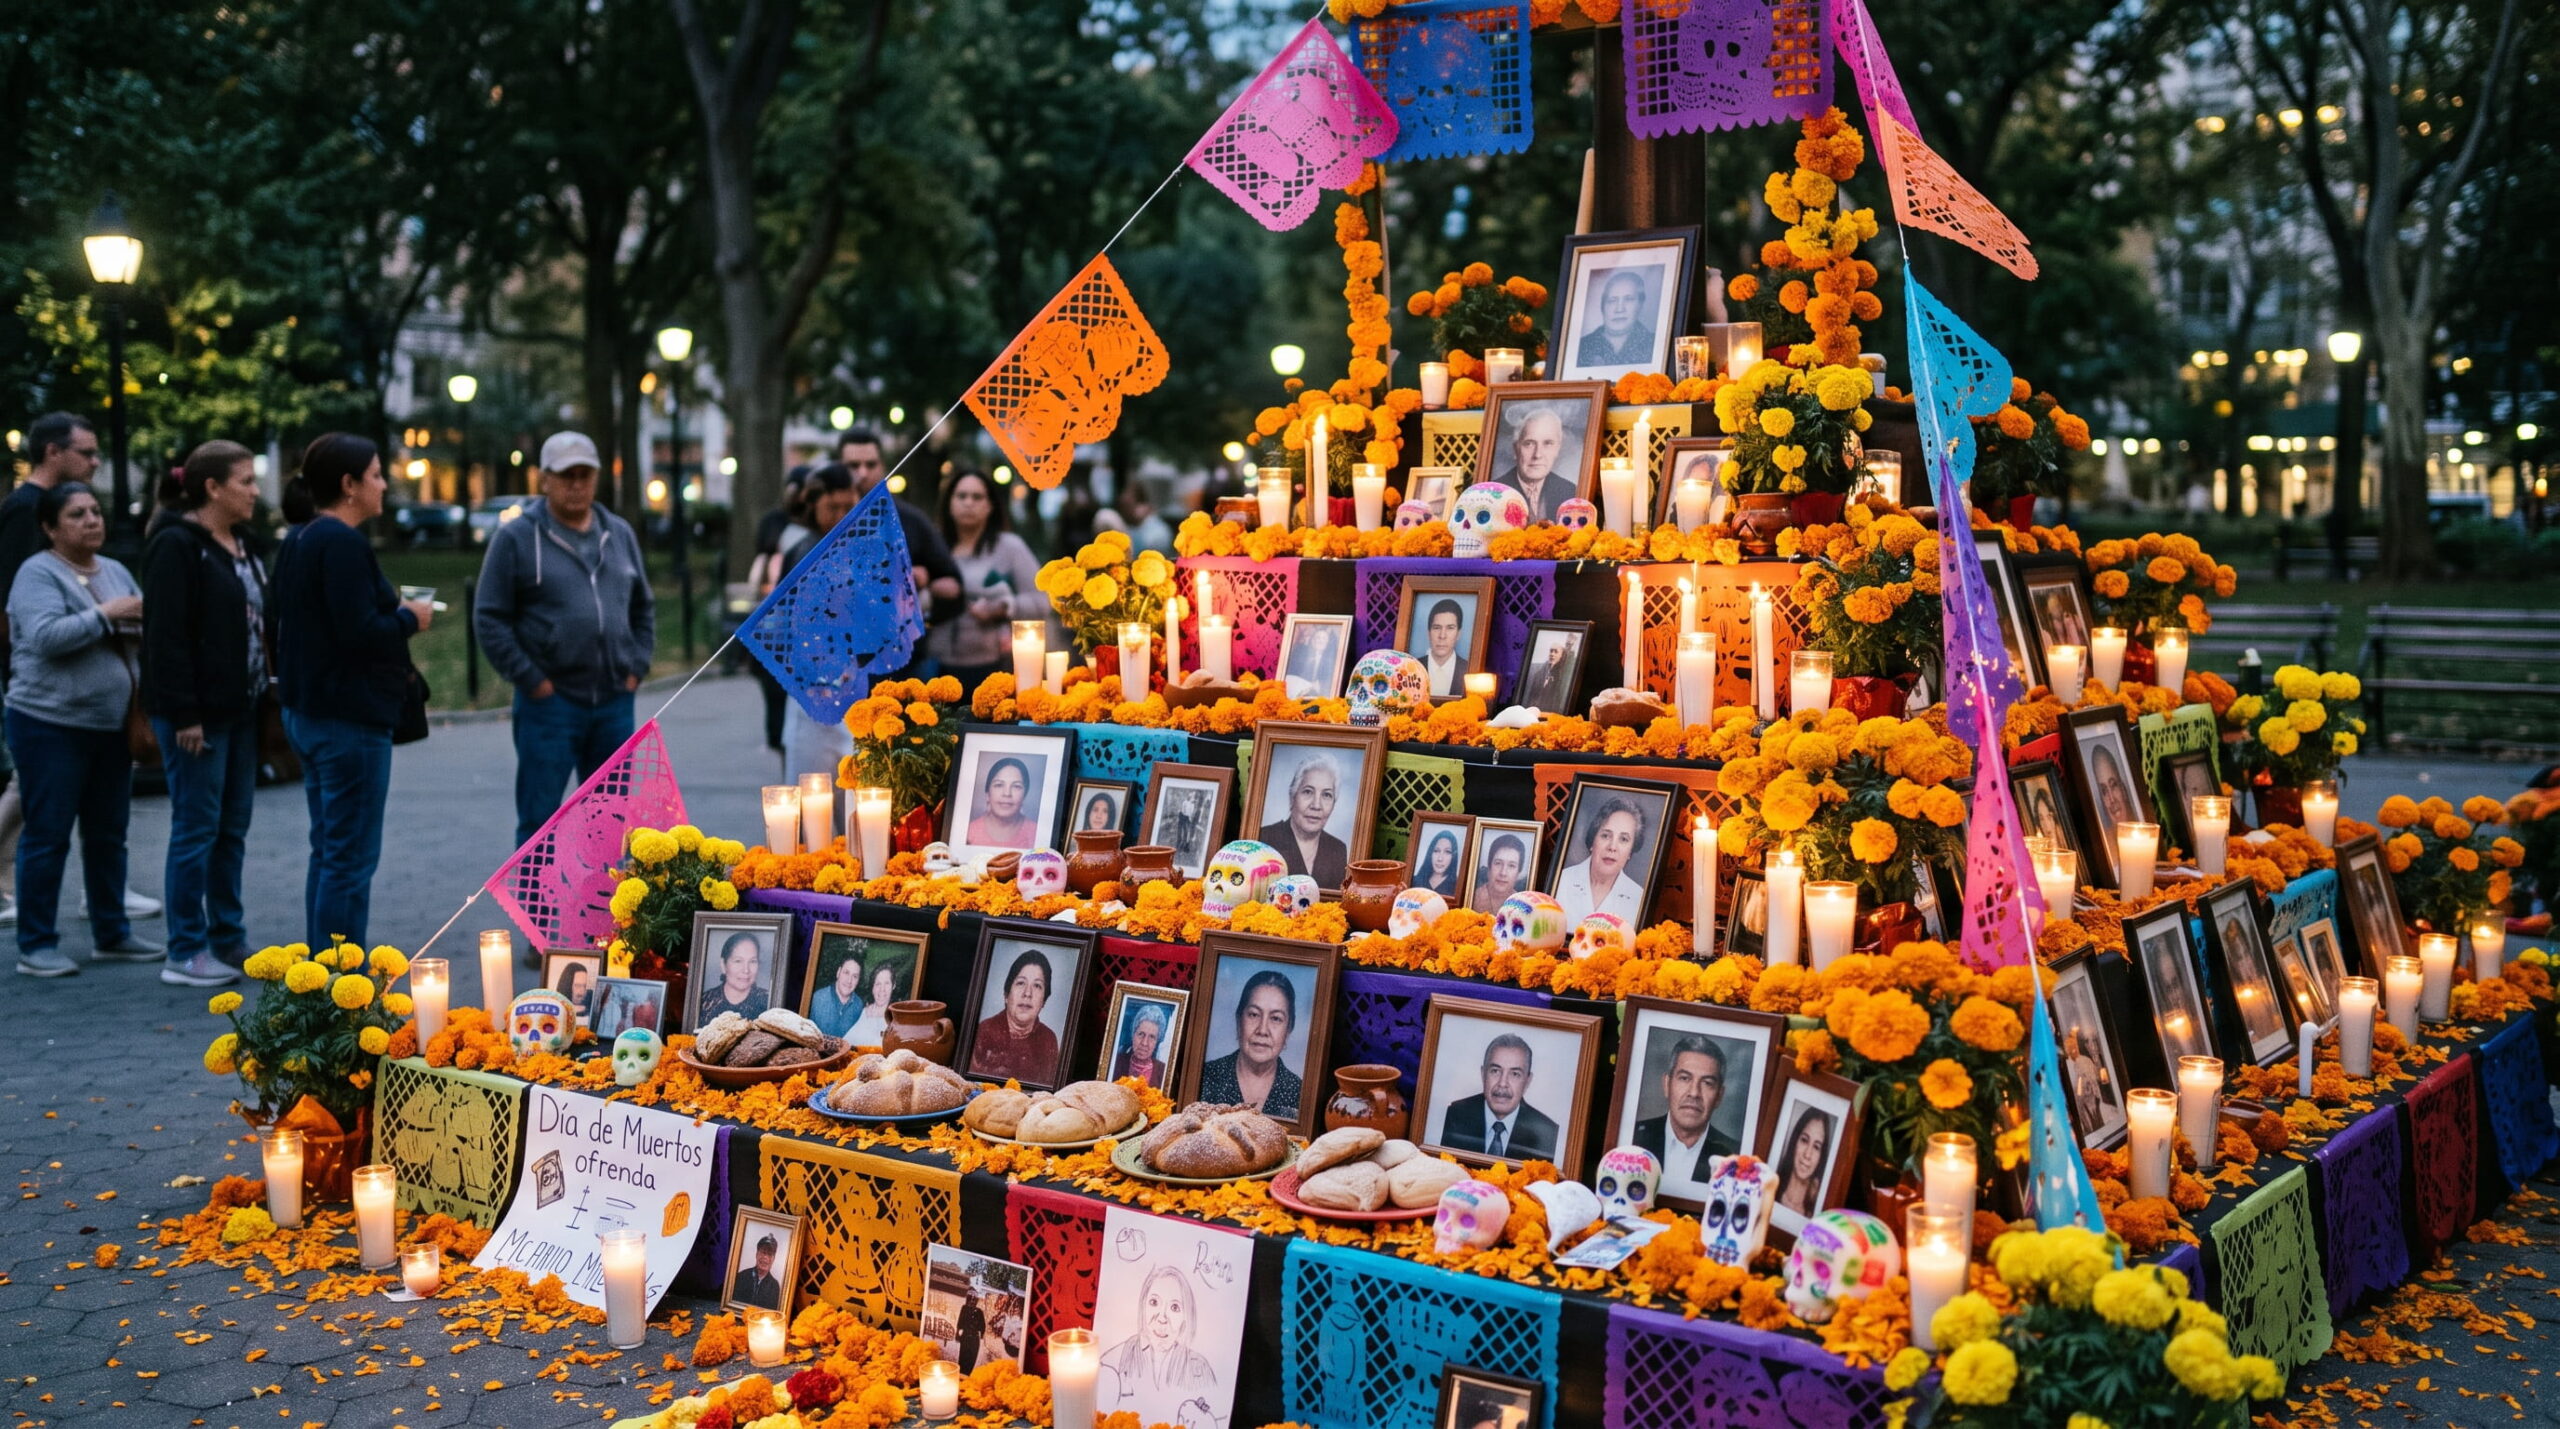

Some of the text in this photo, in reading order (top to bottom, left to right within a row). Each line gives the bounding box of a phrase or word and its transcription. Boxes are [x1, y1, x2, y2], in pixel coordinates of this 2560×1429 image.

[539, 1093, 702, 1167] Día de Muertos
[575, 1150, 656, 1190] ofrenda
